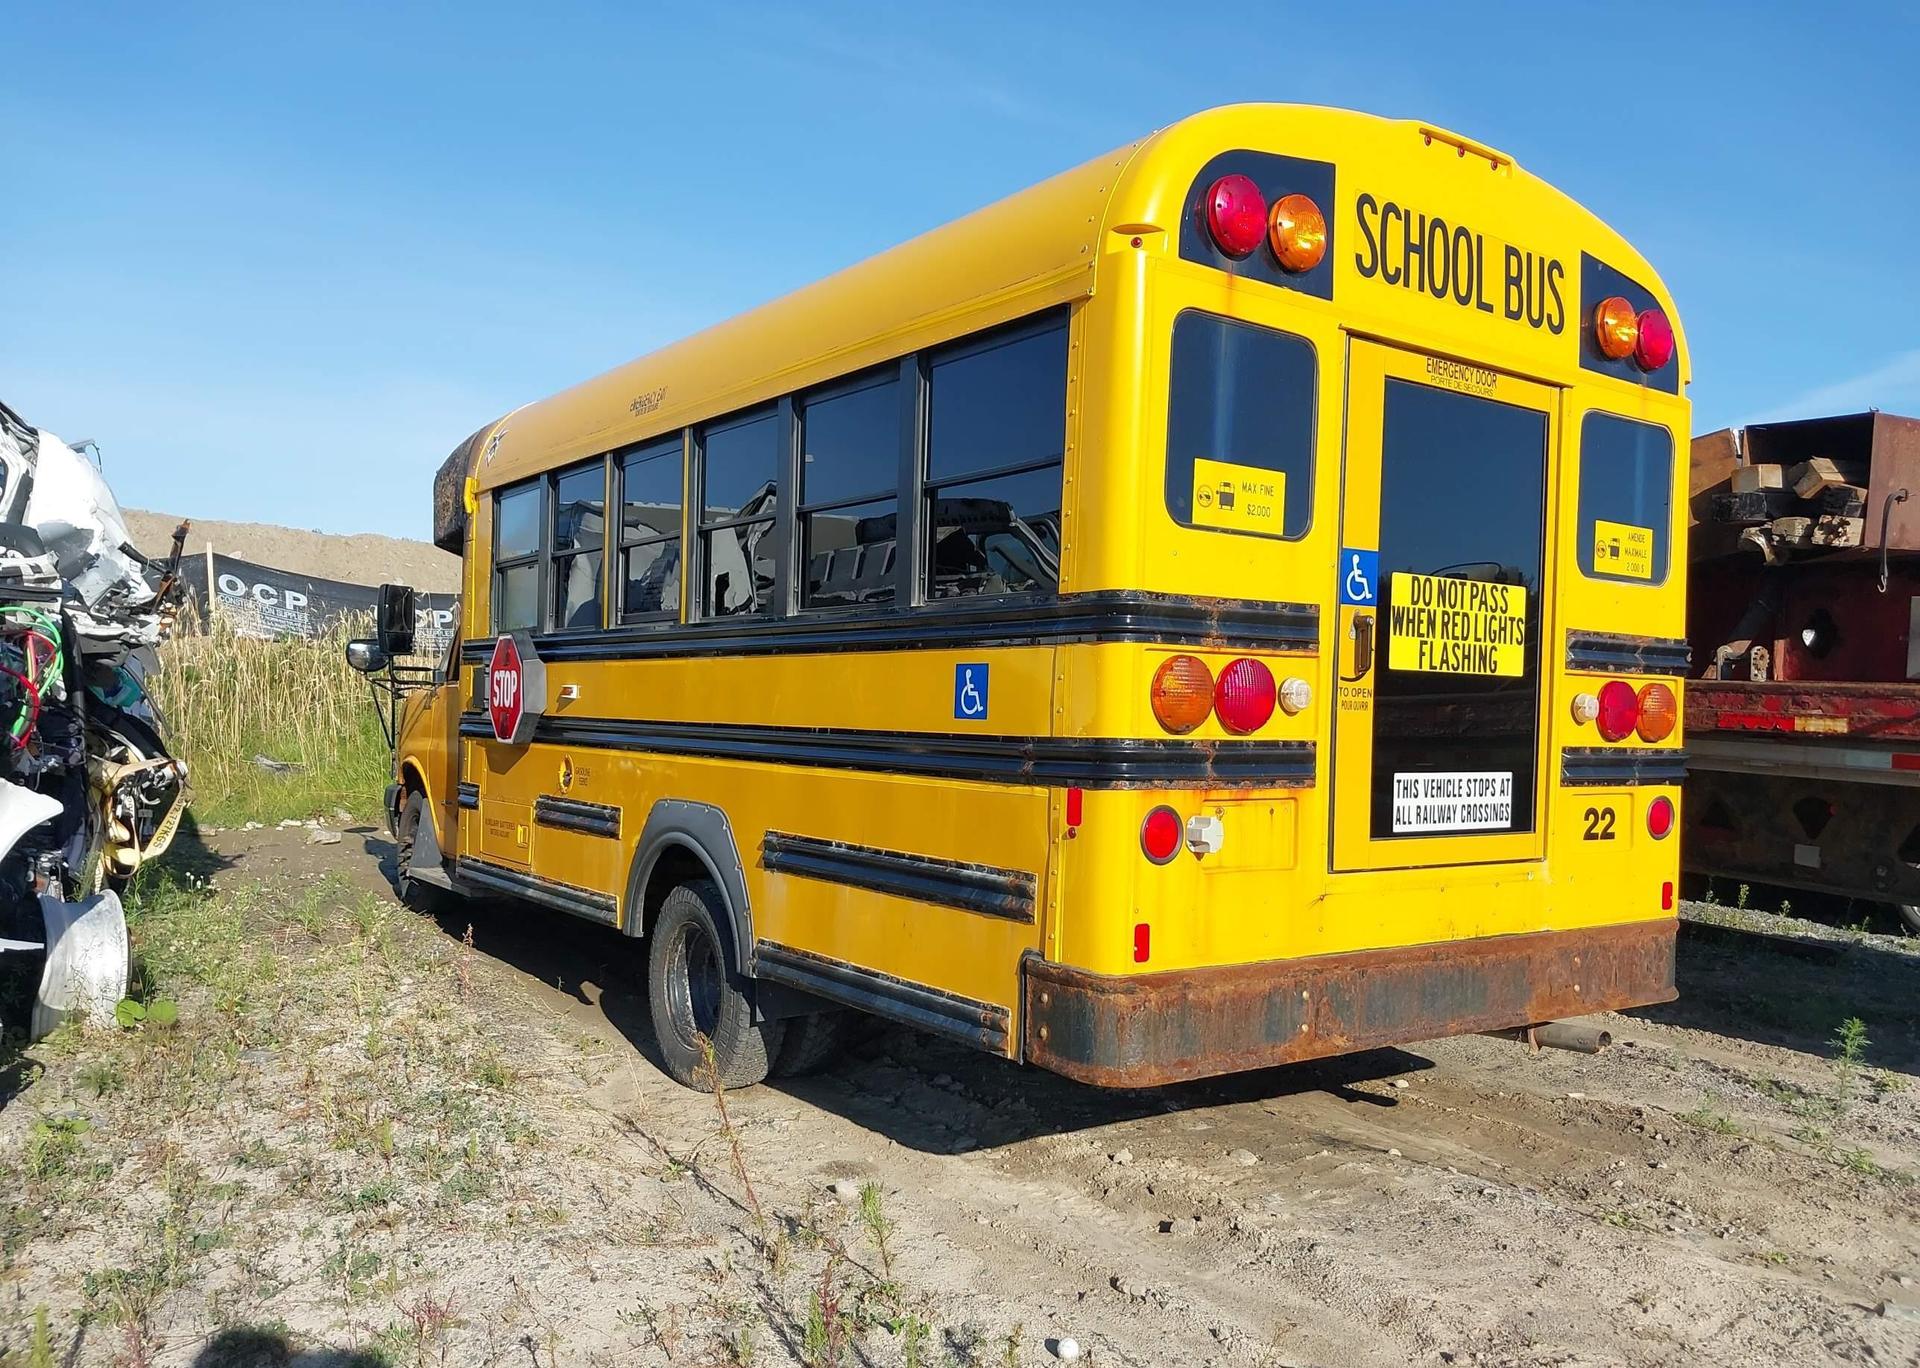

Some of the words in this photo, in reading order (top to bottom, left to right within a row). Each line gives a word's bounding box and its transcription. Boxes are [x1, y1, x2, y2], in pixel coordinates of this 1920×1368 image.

[1355, 192, 1494, 314] SCHOOL
[1504, 243, 1565, 335] BUS
[1426, 357, 1474, 383] EMERGENCY
[1476, 369, 1498, 389] DOOR
[1430, 375, 1453, 388] PORTE
[1453, 380, 1463, 390] DE
[1463, 382, 1494, 397] SECOURS
[1242, 481, 1257, 495] MAX
[1260, 484, 1274, 497] FINE
[218, 573, 308, 610] OCP
[1411, 575, 1433, 607] DO
[1437, 578, 1467, 610] NOT
[1470, 582, 1509, 615] PASS
[1391, 605, 1437, 639] WHEN
[1440, 609, 1471, 641] RED
[1473, 612, 1524, 646] LIGHTS
[1418, 640, 1498, 674] FLASHING
[493, 669, 518, 709] STOP
[1339, 686, 1349, 698] TO
[1351, 687, 1372, 698] OPEN
[1396, 778, 1419, 799] THIS
[1423, 778, 1463, 799] VEHICLE
[1466, 778, 1496, 798] STOPS
[1500, 778, 1511, 797] AT
[1395, 805, 1412, 826] ALL
[1415, 804, 1458, 825] RAILWAY
[1461, 803, 1510, 824] CROSSINGS
[1582, 807, 1616, 841] 22
